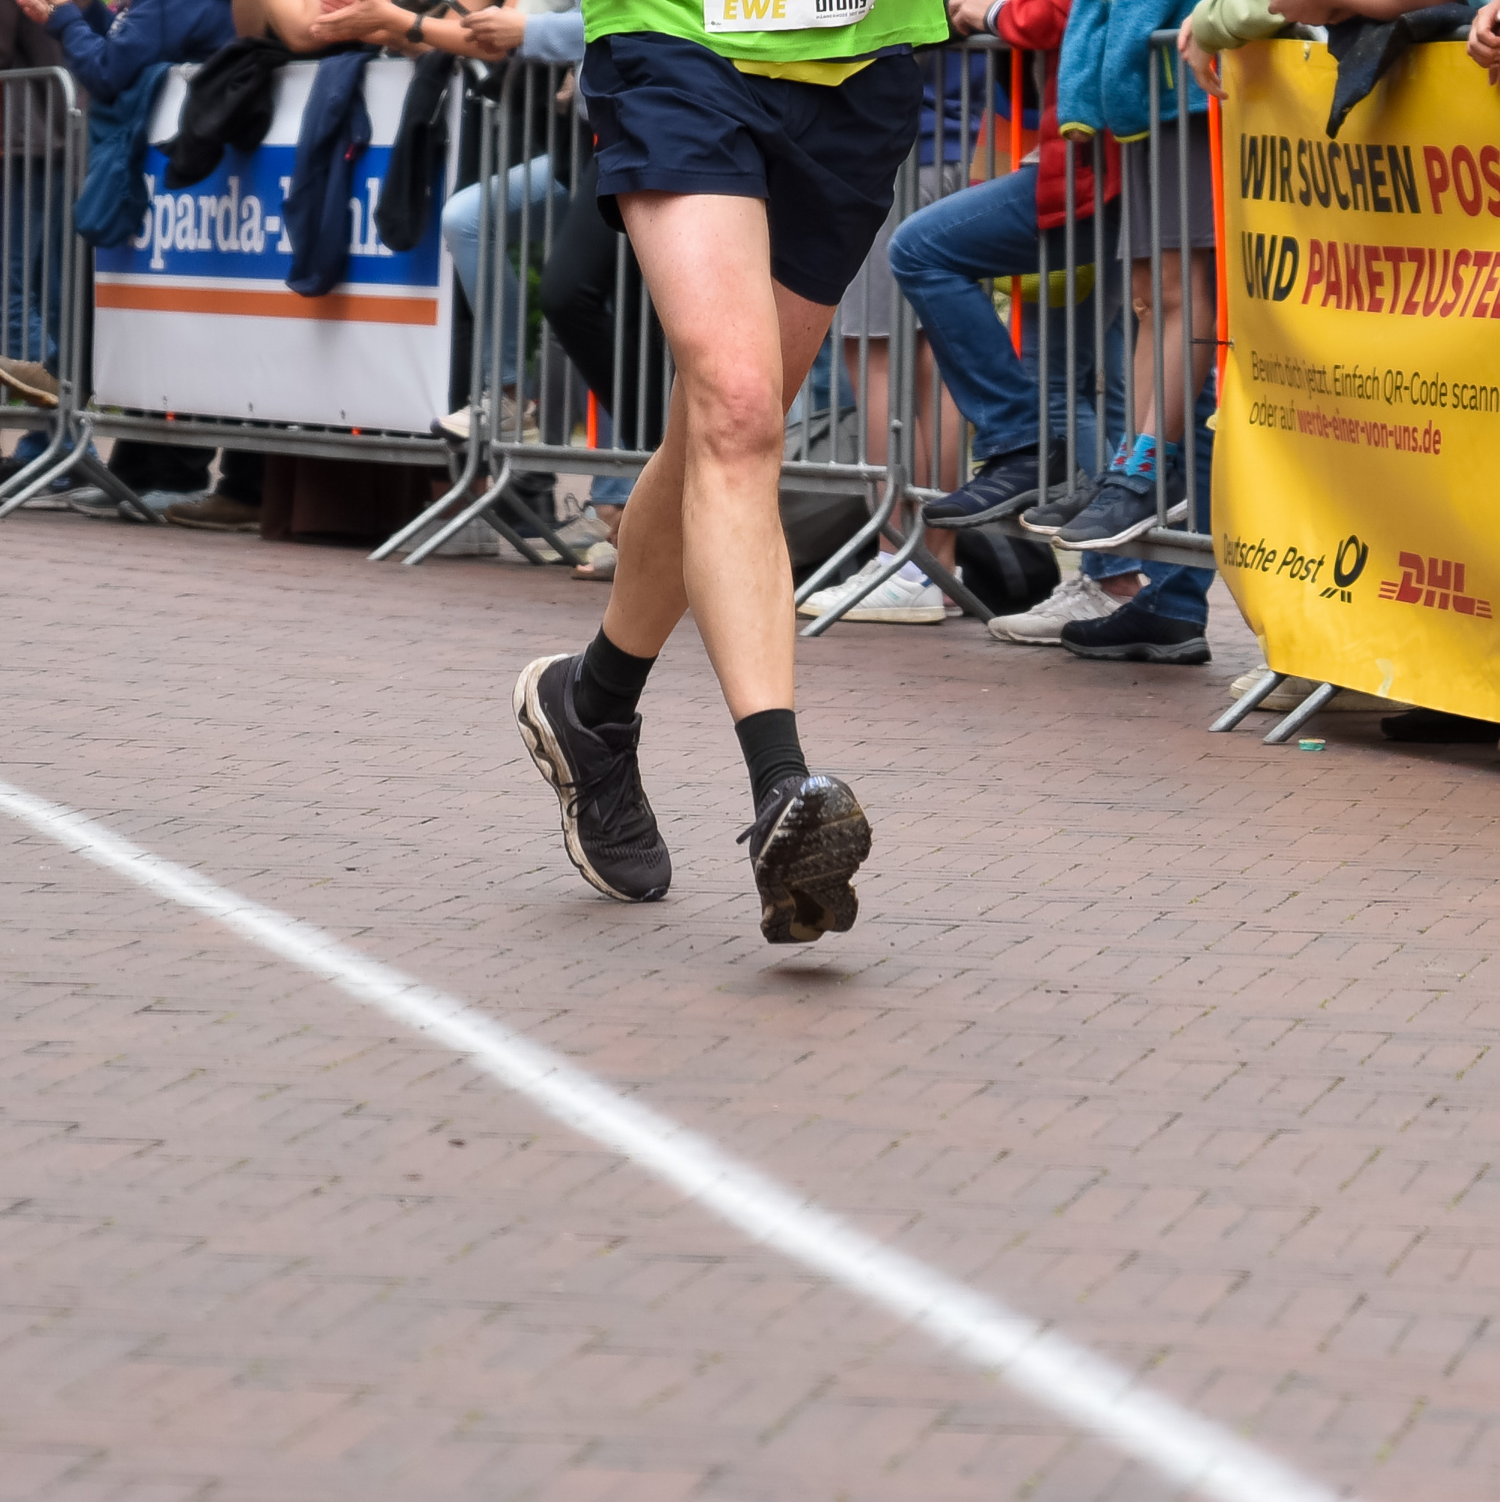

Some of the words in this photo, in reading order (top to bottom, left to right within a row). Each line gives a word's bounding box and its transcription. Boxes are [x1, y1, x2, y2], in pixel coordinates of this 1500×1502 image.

[1240, 133, 1295, 204] WIR
[1297, 137, 1421, 214] SUCHEN
[1241, 230, 1300, 302] UND
[1333, 365, 1380, 400] Einfach
[1384, 368, 1448, 408] QR-Code
[1249, 395, 1278, 426] oder
[1297, 406, 1442, 455] werde-einer-von-uns.de
[1223, 533, 1276, 572] Deutsche
[1276, 546, 1326, 584] Post
[1393, 550, 1478, 617] DHL
